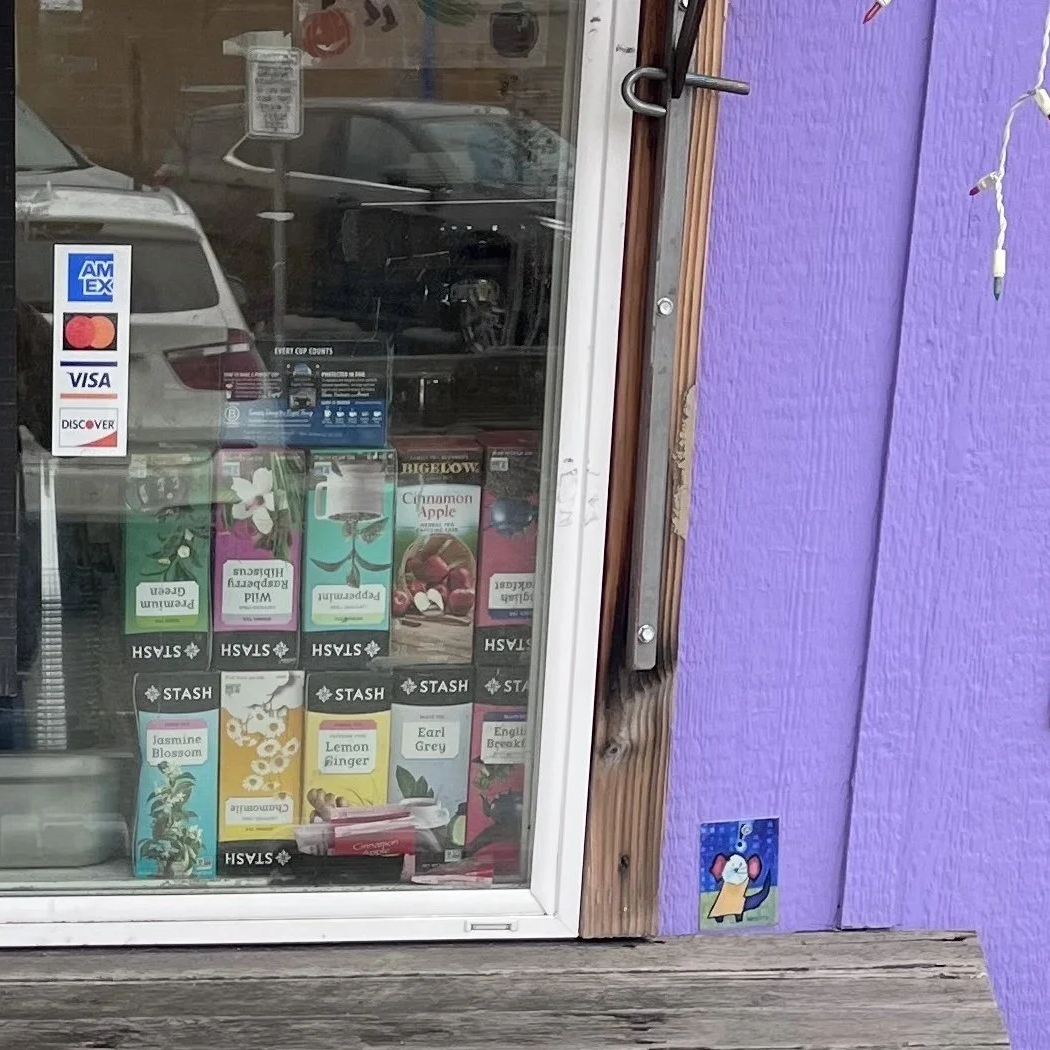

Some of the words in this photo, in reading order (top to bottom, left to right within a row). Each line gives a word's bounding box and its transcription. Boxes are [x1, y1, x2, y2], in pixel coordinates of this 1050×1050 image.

[81, 262, 114, 277] AM
[85, 279, 114, 293] EX
[274, 347, 294, 355] EVERY
[295, 347, 307, 355] CUP
[308, 347, 334, 355] COUNTS
[67, 372, 111, 388] VISA
[61, 419, 115, 430] DISCOVER
[401, 462, 479, 474] BIGELOW
[402, 491, 473, 504] Cinnamon
[418, 505, 456, 520] Apple
[232, 567, 284, 578] Hibiscus
[227, 578, 289, 590] Raspberry
[494, 580, 535, 592] akfast
[150, 586, 186, 597] Green
[244, 591, 271, 603] Wild
[317, 590, 381, 602] Peppermint
[501, 592, 534, 604] glish
[139, 598, 195, 611] Premium
[132, 644, 182, 659] STASH
[221, 643, 271, 657] STASH
[312, 643, 362, 657] STASH
[419, 679, 469, 694] STASH
[163, 686, 212, 701] STASH
[334, 686, 385, 702] STASH
[417, 726, 446, 738] Earl
[152, 735, 202, 746] Jasmine
[325, 741, 369, 752] Lemon
[415, 740, 447, 753] Grey
[151, 748, 202, 759] Blossom
[324, 755, 370, 769] Ginger
[230, 803, 289, 813] Chamomile
[225, 852, 273, 865] STASH
